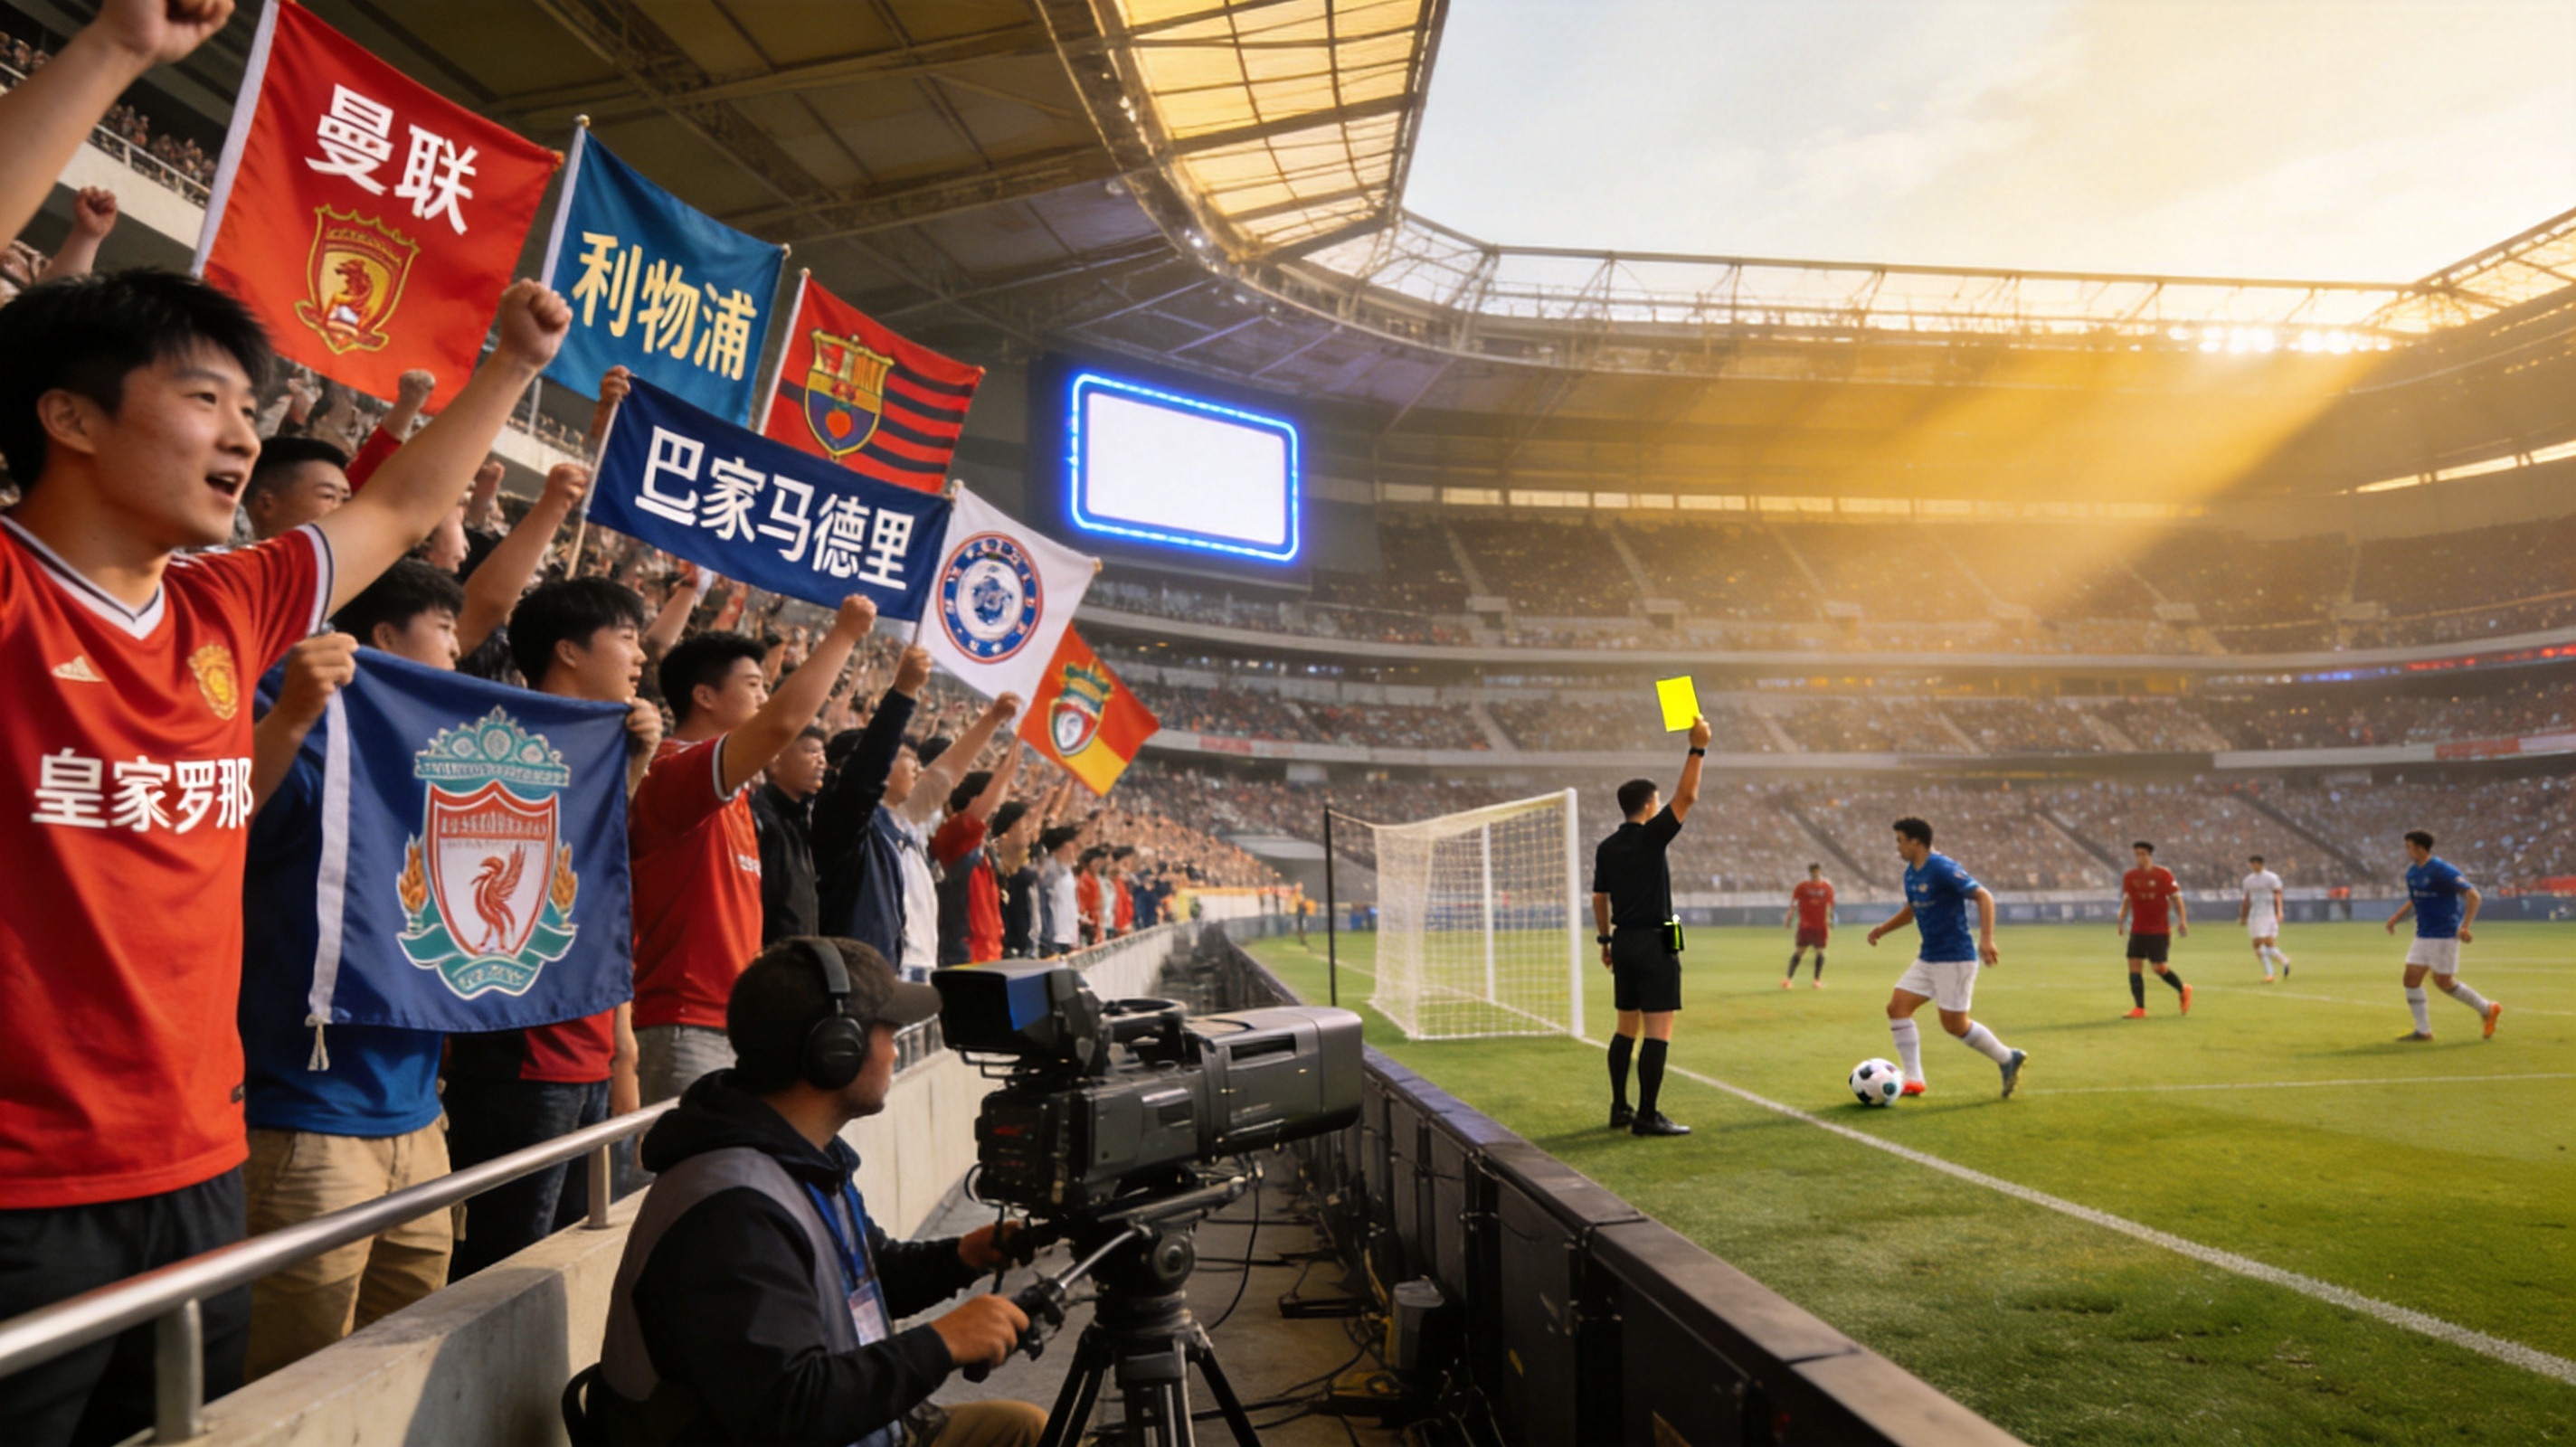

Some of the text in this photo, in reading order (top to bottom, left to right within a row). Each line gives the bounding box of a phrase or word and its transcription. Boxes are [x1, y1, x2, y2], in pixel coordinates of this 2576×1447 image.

[305, 83, 479, 235] 曼联
[572, 231, 758, 381] 利物浦
[30, 747, 254, 834] 皇家罗那
